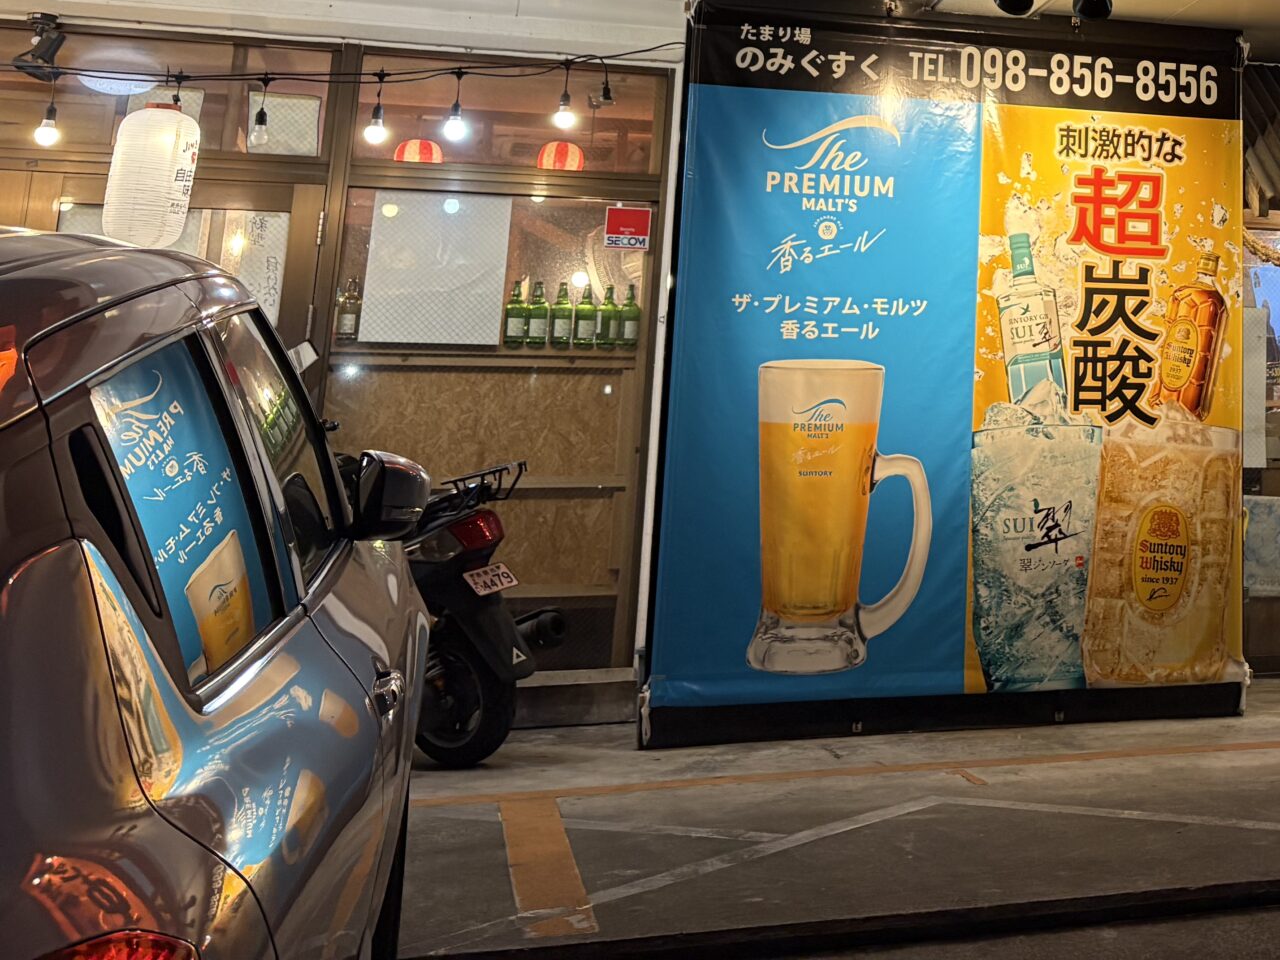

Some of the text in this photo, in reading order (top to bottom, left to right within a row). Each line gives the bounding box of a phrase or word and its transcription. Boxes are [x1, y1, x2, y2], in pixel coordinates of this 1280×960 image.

[740, 22, 812, 45] たまり場
[735, 46, 881, 81] のみぐすく
[960, 45, 1219, 105] 098-856-8556
[1057, 125, 1184, 163] 刺激的な
[766, 171, 895, 198] PREMIUM
[802, 197, 858, 213] MALT'S
[607, 236, 646, 246] SECOM
[766, 233, 887, 274] 香るエール
[731, 293, 929, 316] ザ・プレミアム・モルツ
[780, 320, 880, 340] 香るエール
[1010, 325, 1034, 340] SUI
[793, 423, 844, 432] PREMIUM
[1003, 517, 1035, 534] SUI
[1139, 540, 1187, 559] Suntory
[1139, 556, 1184, 575] Whisky
[1141, 575, 1178, 585] since 1937
